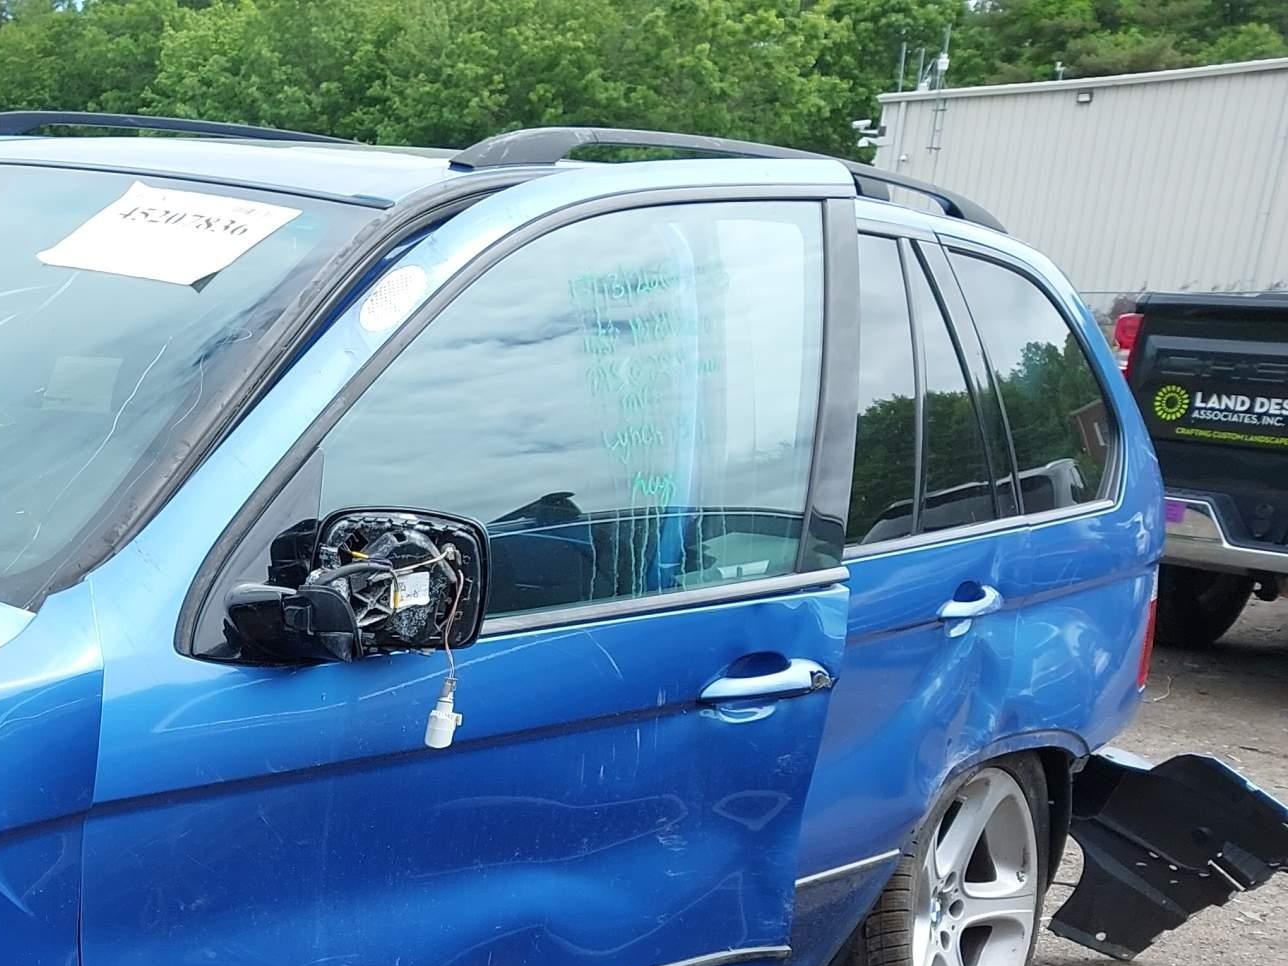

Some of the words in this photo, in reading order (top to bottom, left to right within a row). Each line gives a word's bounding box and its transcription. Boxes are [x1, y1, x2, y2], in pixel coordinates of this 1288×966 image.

[117, 206, 249, 237] 45207836
[1194, 391, 1251, 412] LAND
[1192, 409, 1261, 425] ASSOCIATES,
[1262, 415, 1286, 427] INC.
[1175, 426, 1212, 438] CRAFTING
[1212, 430, 1244, 441] CUSTOM
